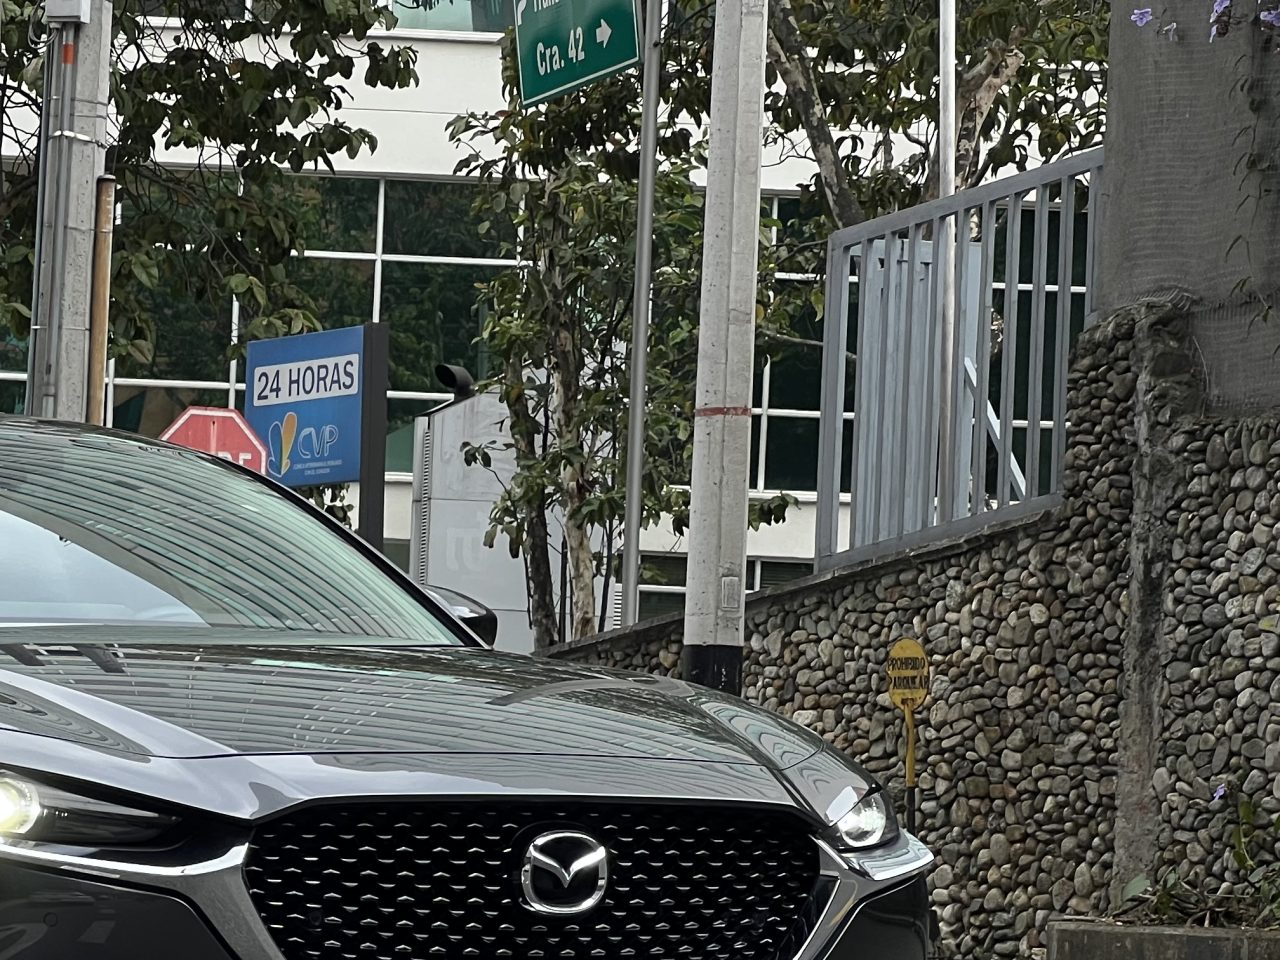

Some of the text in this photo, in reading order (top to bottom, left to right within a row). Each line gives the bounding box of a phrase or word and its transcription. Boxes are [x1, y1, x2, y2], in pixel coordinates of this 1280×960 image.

[536, 26, 585, 76] Cra. 42
[257, 360, 355, 401] 24 HORAS
[298, 424, 339, 459] CVP
